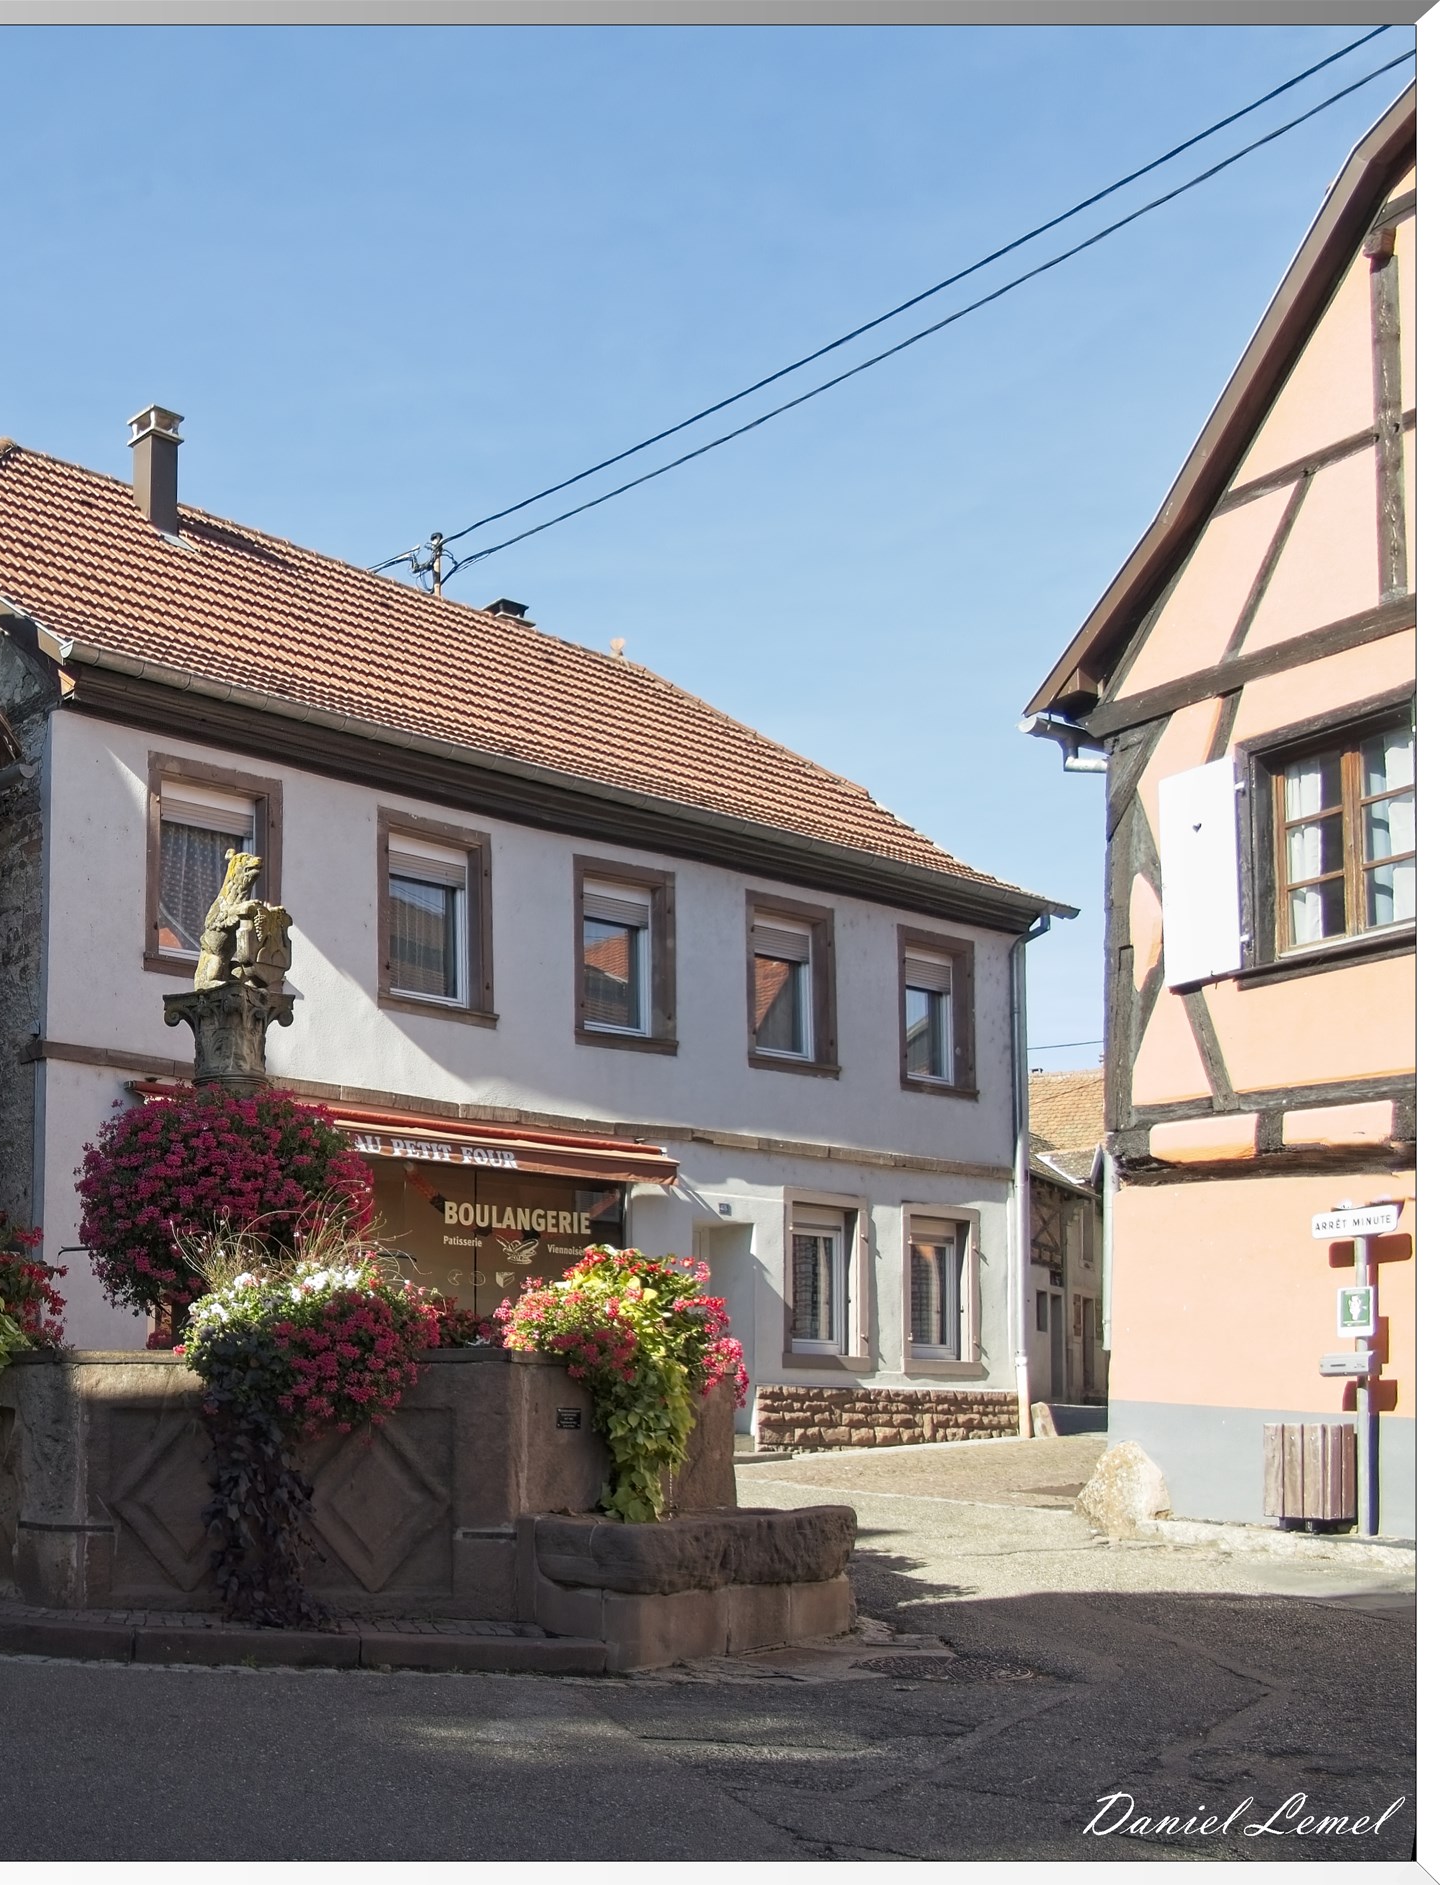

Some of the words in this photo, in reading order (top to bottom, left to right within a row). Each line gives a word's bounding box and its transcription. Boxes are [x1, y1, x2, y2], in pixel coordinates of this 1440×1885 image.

[354, 1134, 381, 1154] AU
[390, 1138, 452, 1162] PETIT
[460, 1146, 518, 1169] FOUR
[444, 1201, 591, 1235] BOULANGERIE
[1315, 1218, 1347, 1231] ARRÊT
[1352, 1214, 1391, 1227] MINUTE
[443, 1235, 483, 1248] Patisserie
